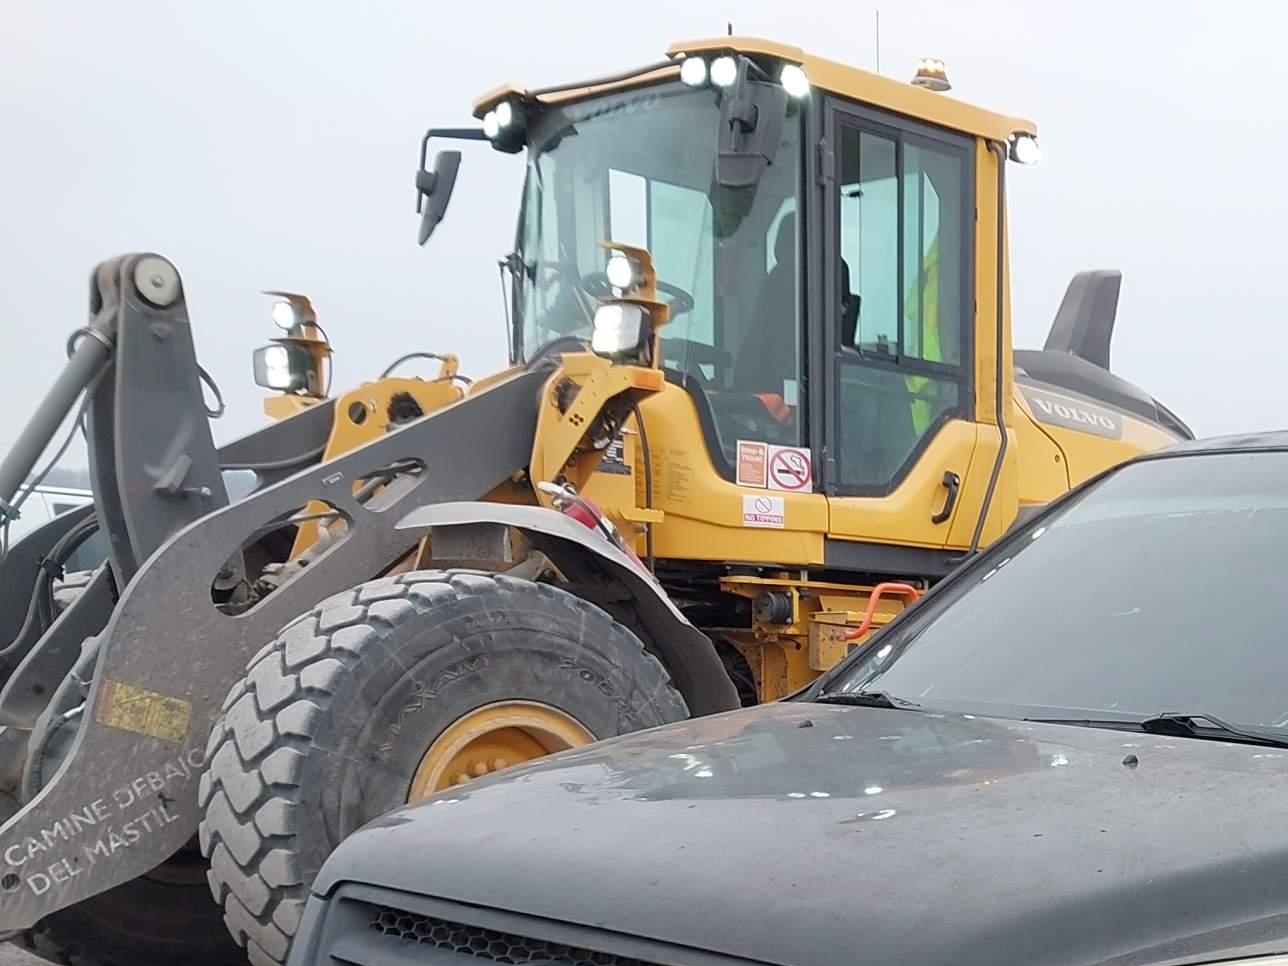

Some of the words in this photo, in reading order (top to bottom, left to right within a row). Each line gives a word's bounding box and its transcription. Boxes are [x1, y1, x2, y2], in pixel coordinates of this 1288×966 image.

[1032, 398, 1116, 431] VOLVO
[757, 514, 782, 523] TIPPING
[4, 798, 111, 867] CAMINE
[112, 748, 207, 811] DEBAJO
[26, 857, 84, 896] DEL
[84, 803, 179, 865] MÁSTIL
